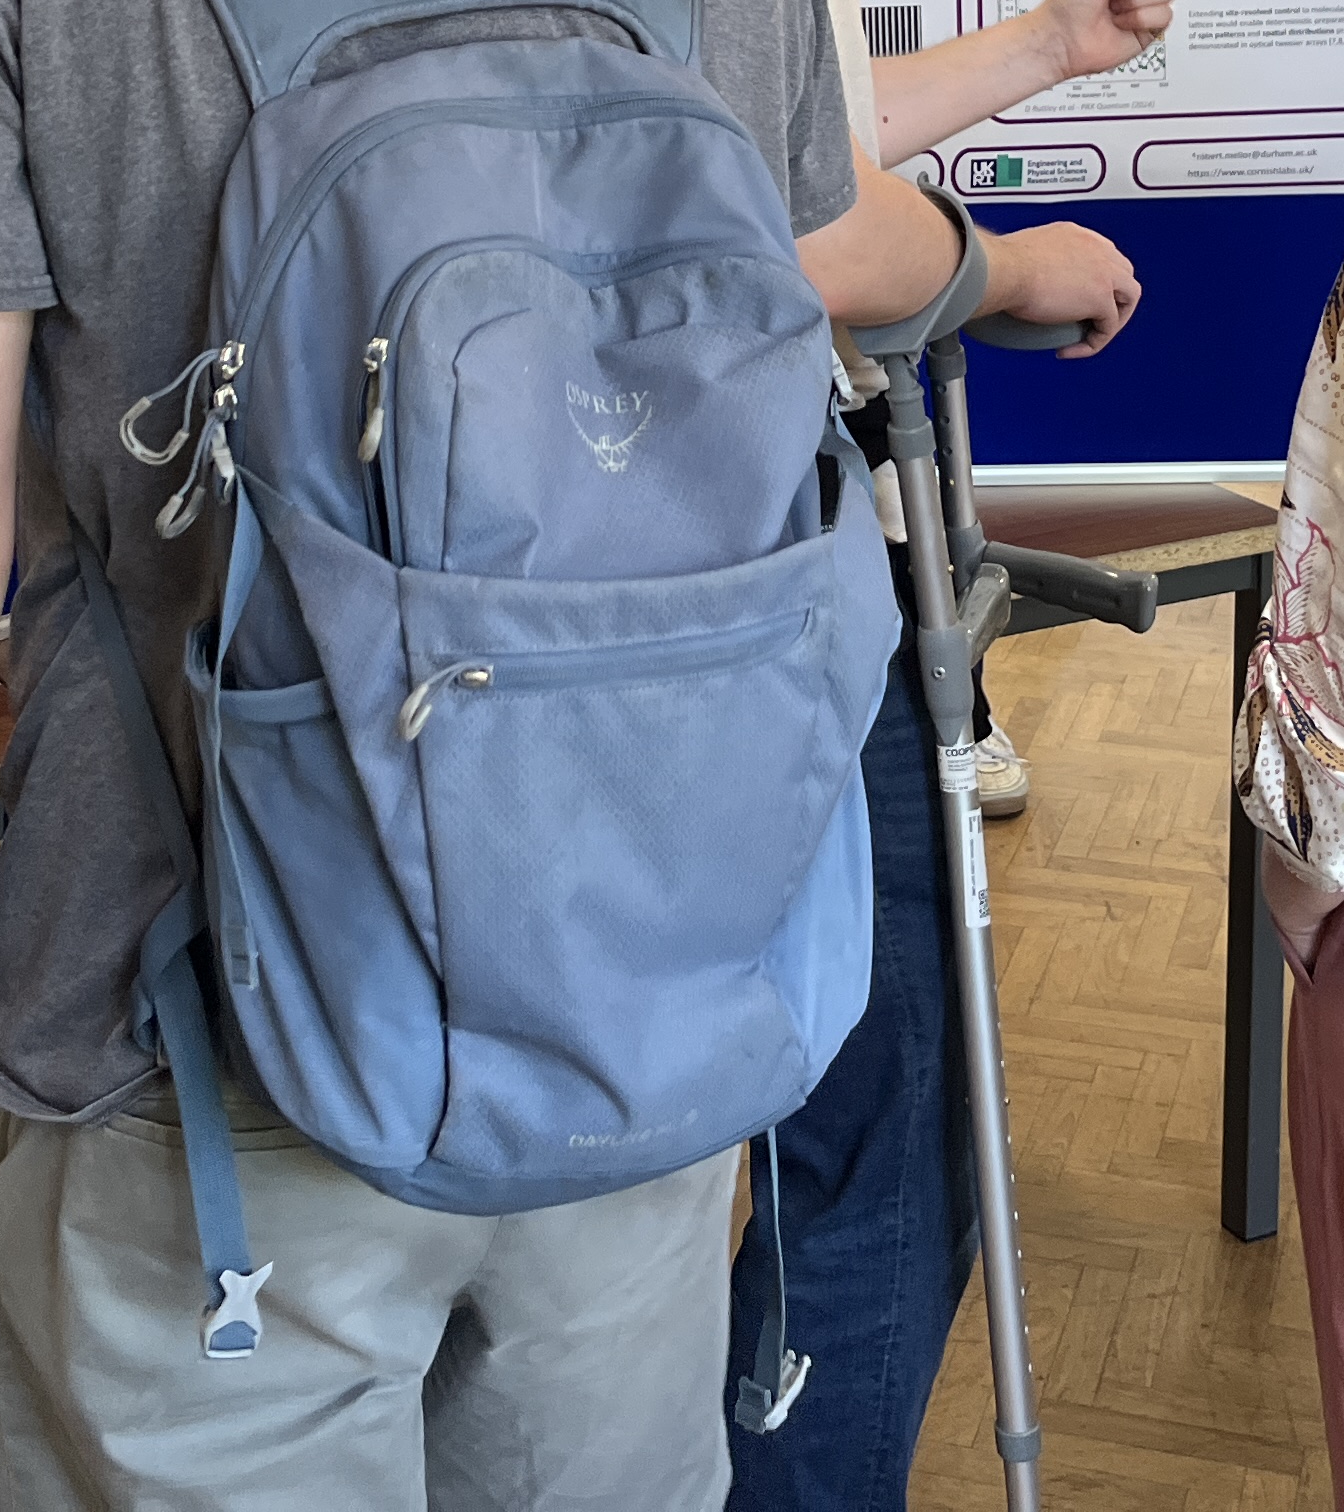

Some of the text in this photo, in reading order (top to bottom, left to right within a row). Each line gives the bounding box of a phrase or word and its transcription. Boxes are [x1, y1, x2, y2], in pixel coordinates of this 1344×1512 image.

[1027, 158, 1083, 169] Engineering and
[1027, 168, 1088, 177] Physical Sciences
[1026, 175, 1086, 184] Research Council
[566, 381, 649, 415] OSPREY
